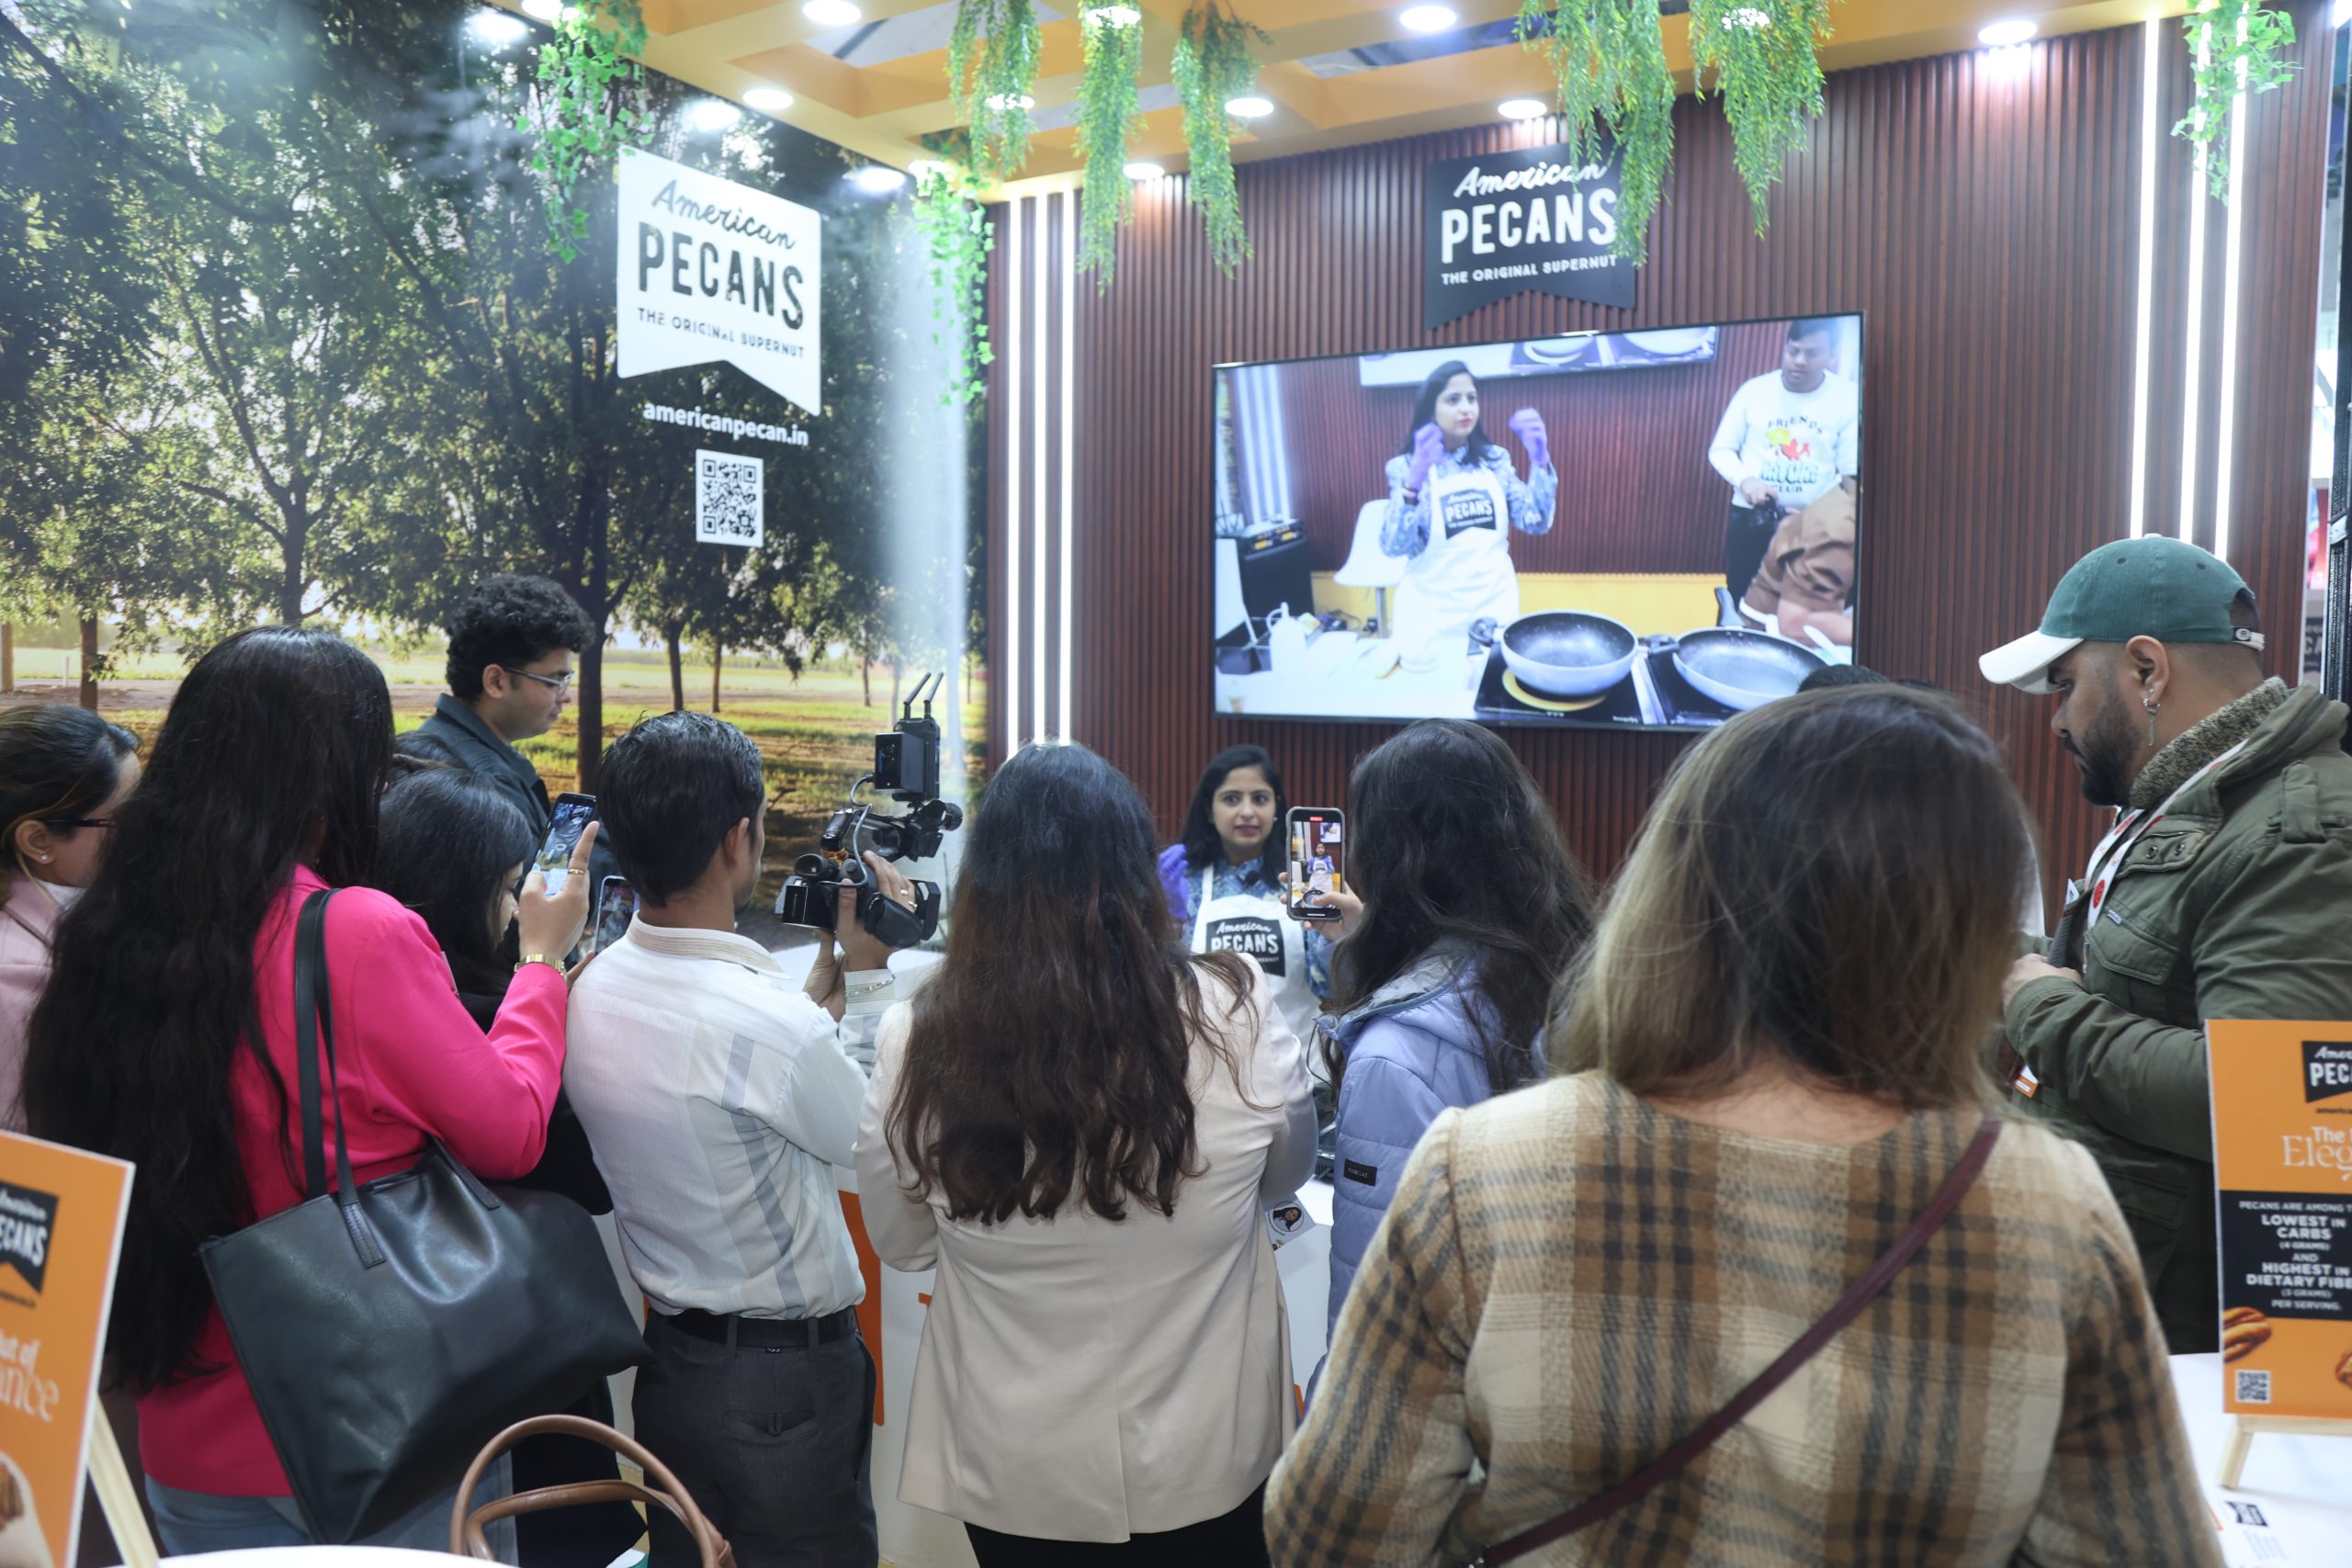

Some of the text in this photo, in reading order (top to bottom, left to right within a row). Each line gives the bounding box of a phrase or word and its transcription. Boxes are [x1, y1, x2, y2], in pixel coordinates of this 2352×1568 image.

[1453, 162, 1607, 198] American
[651, 179, 796, 250] American
[1442, 187, 1618, 264] PECANS
[639, 221, 804, 330] PECANS
[1441, 254, 1618, 285] THE ORIGINAL SUPERNUT
[638, 308, 805, 357] THE ORIGINAL SUPERNUT
[643, 402, 809, 446] americanpecan.in
[1445, 500, 1494, 523] PECANS
[1216, 921, 1272, 935] American
[1210, 933, 1279, 954] PECANS
[2310, 1063, 2352, 1087] PEC
[2311, 1126, 2345, 1144] The
[2239, 1201, 2280, 1211] PECANS
[2282, 1201, 2302, 1211] ARE
[2305, 1203, 2345, 1213] AMONG
[2261, 1214, 2346, 1228] LOWEST IN
[2277, 1227, 2332, 1240] CARBS
[2292, 1253, 2319, 1262] AND
[2261, 1262, 2350, 1276] HIGHEST IN
[2245, 1273, 2315, 1287] DIETARY
[2271, 1300, 2291, 1308] PER
